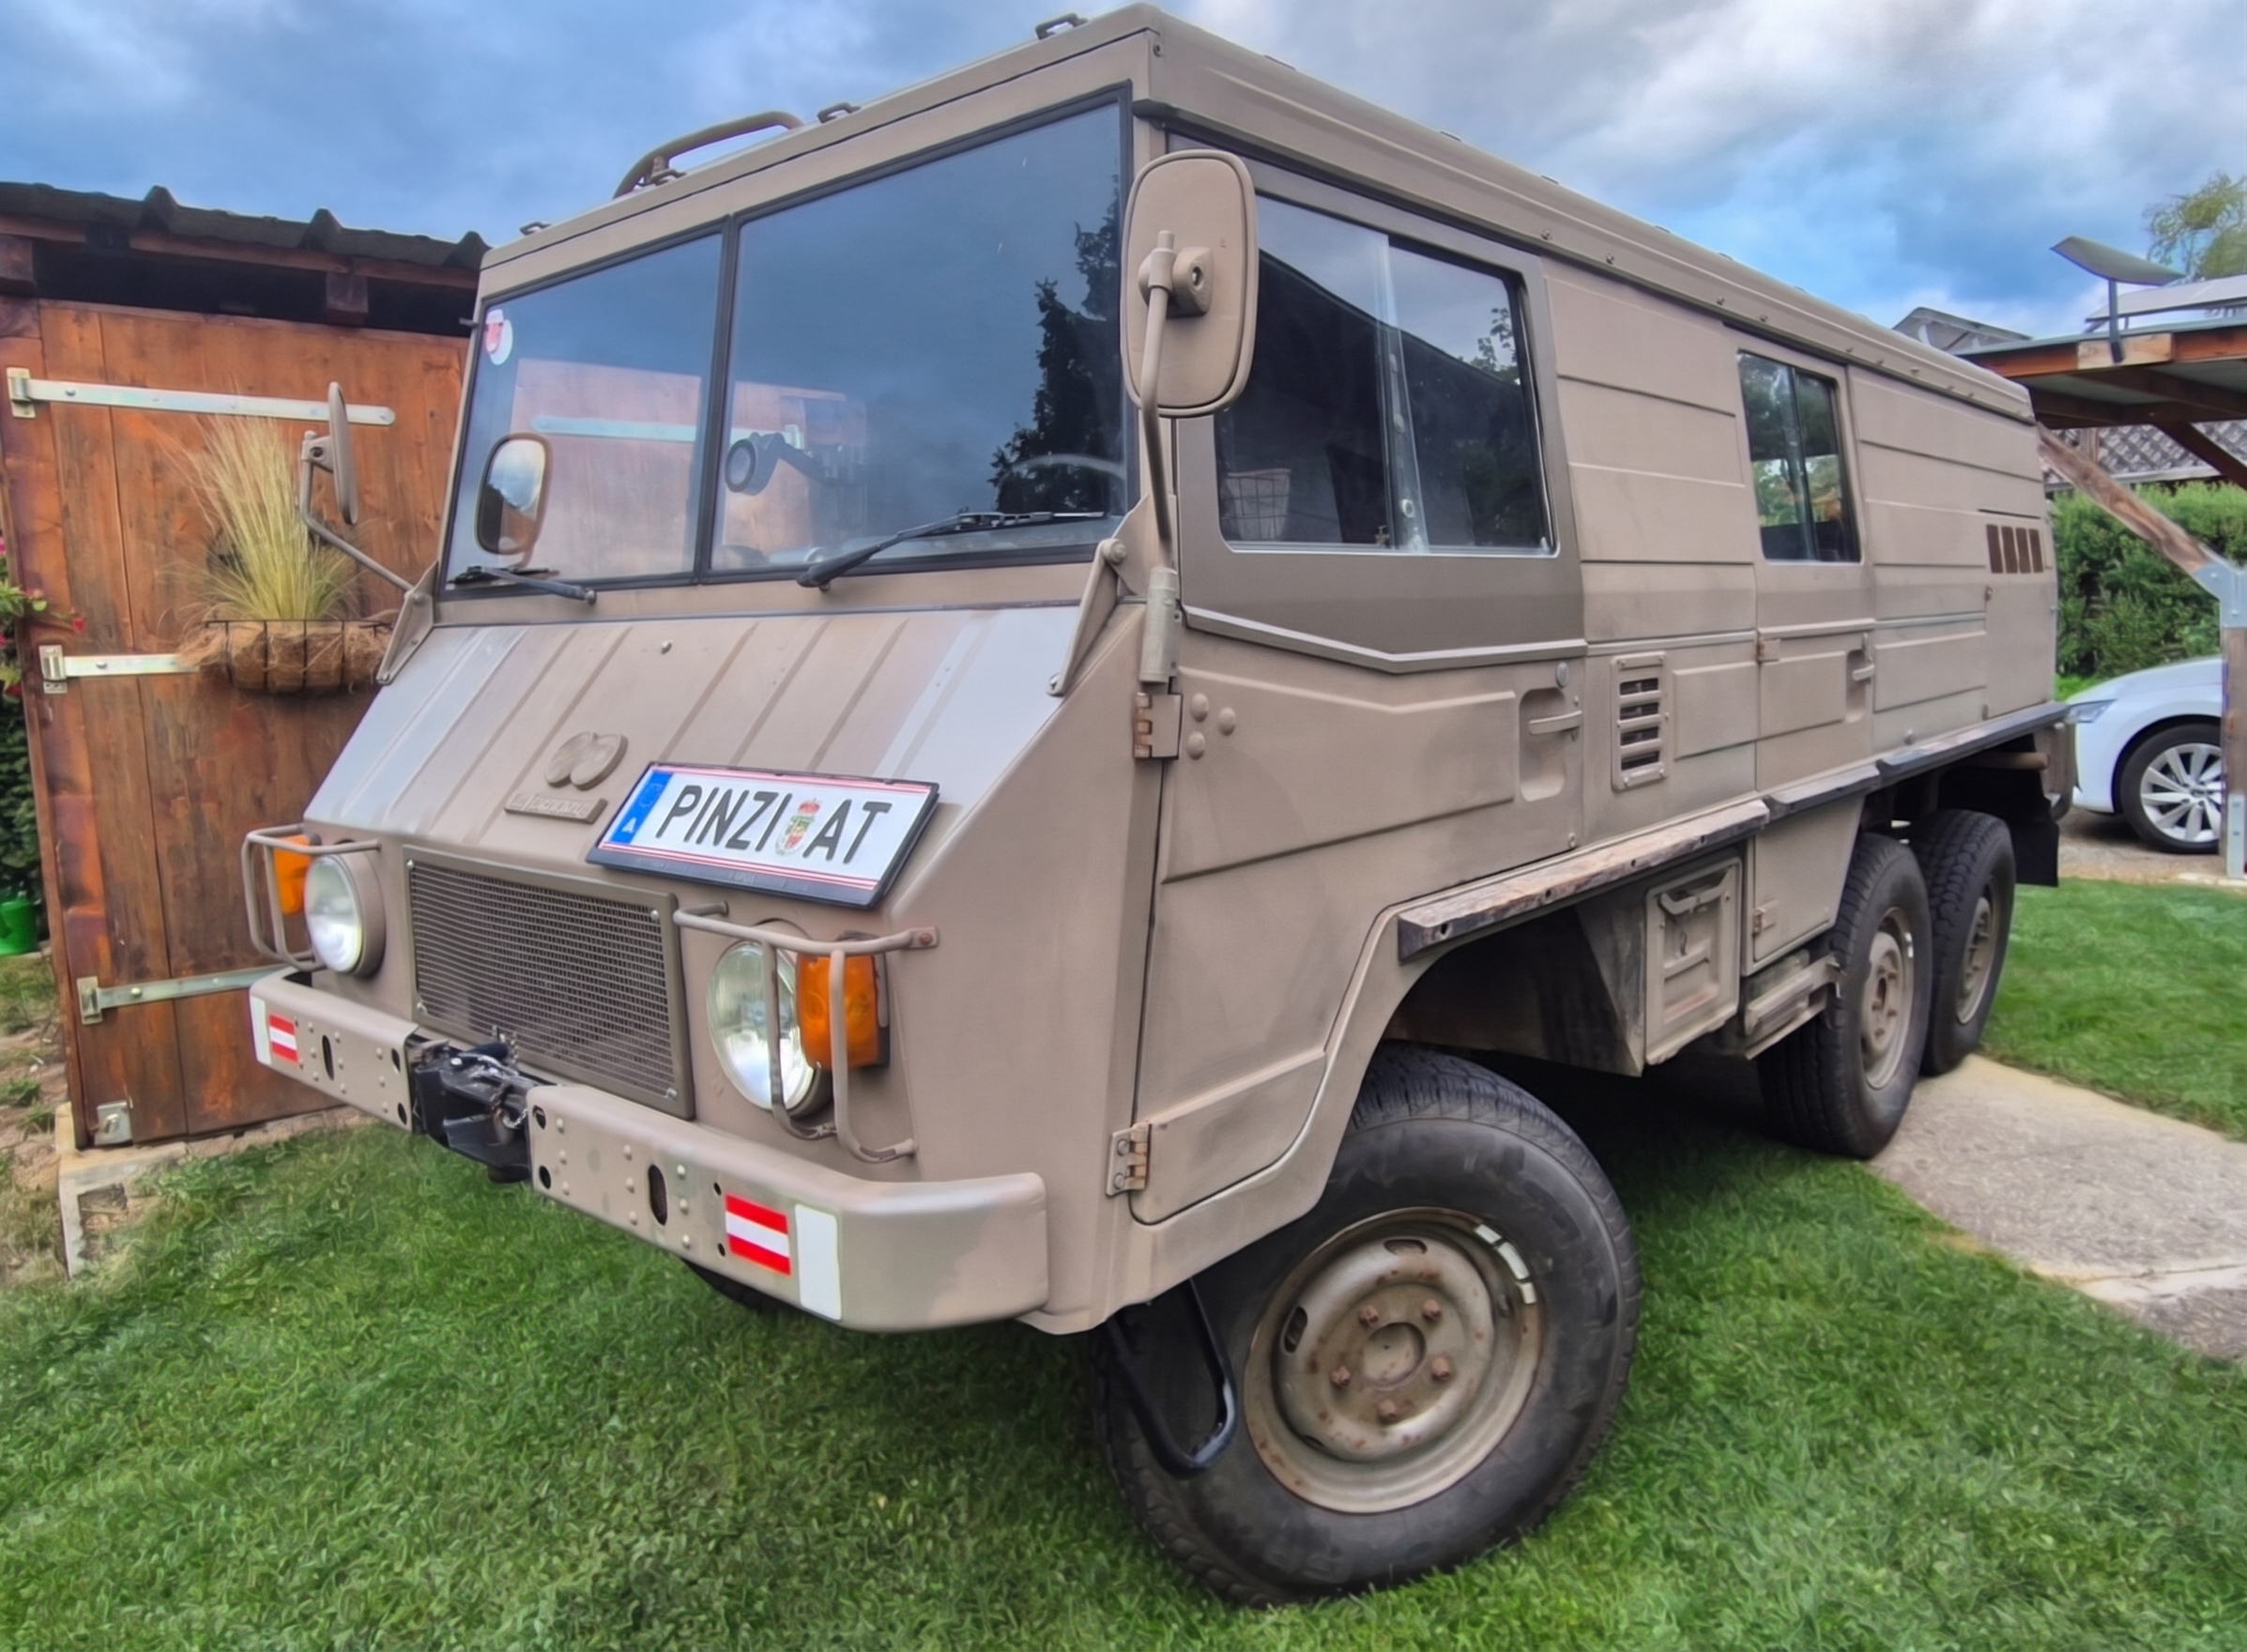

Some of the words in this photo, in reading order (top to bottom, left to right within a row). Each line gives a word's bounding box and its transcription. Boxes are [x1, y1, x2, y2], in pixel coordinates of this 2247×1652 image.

[621, 818, 636, 834] A
[655, 785, 792, 851] PINZI
[802, 799, 893, 864] AT
